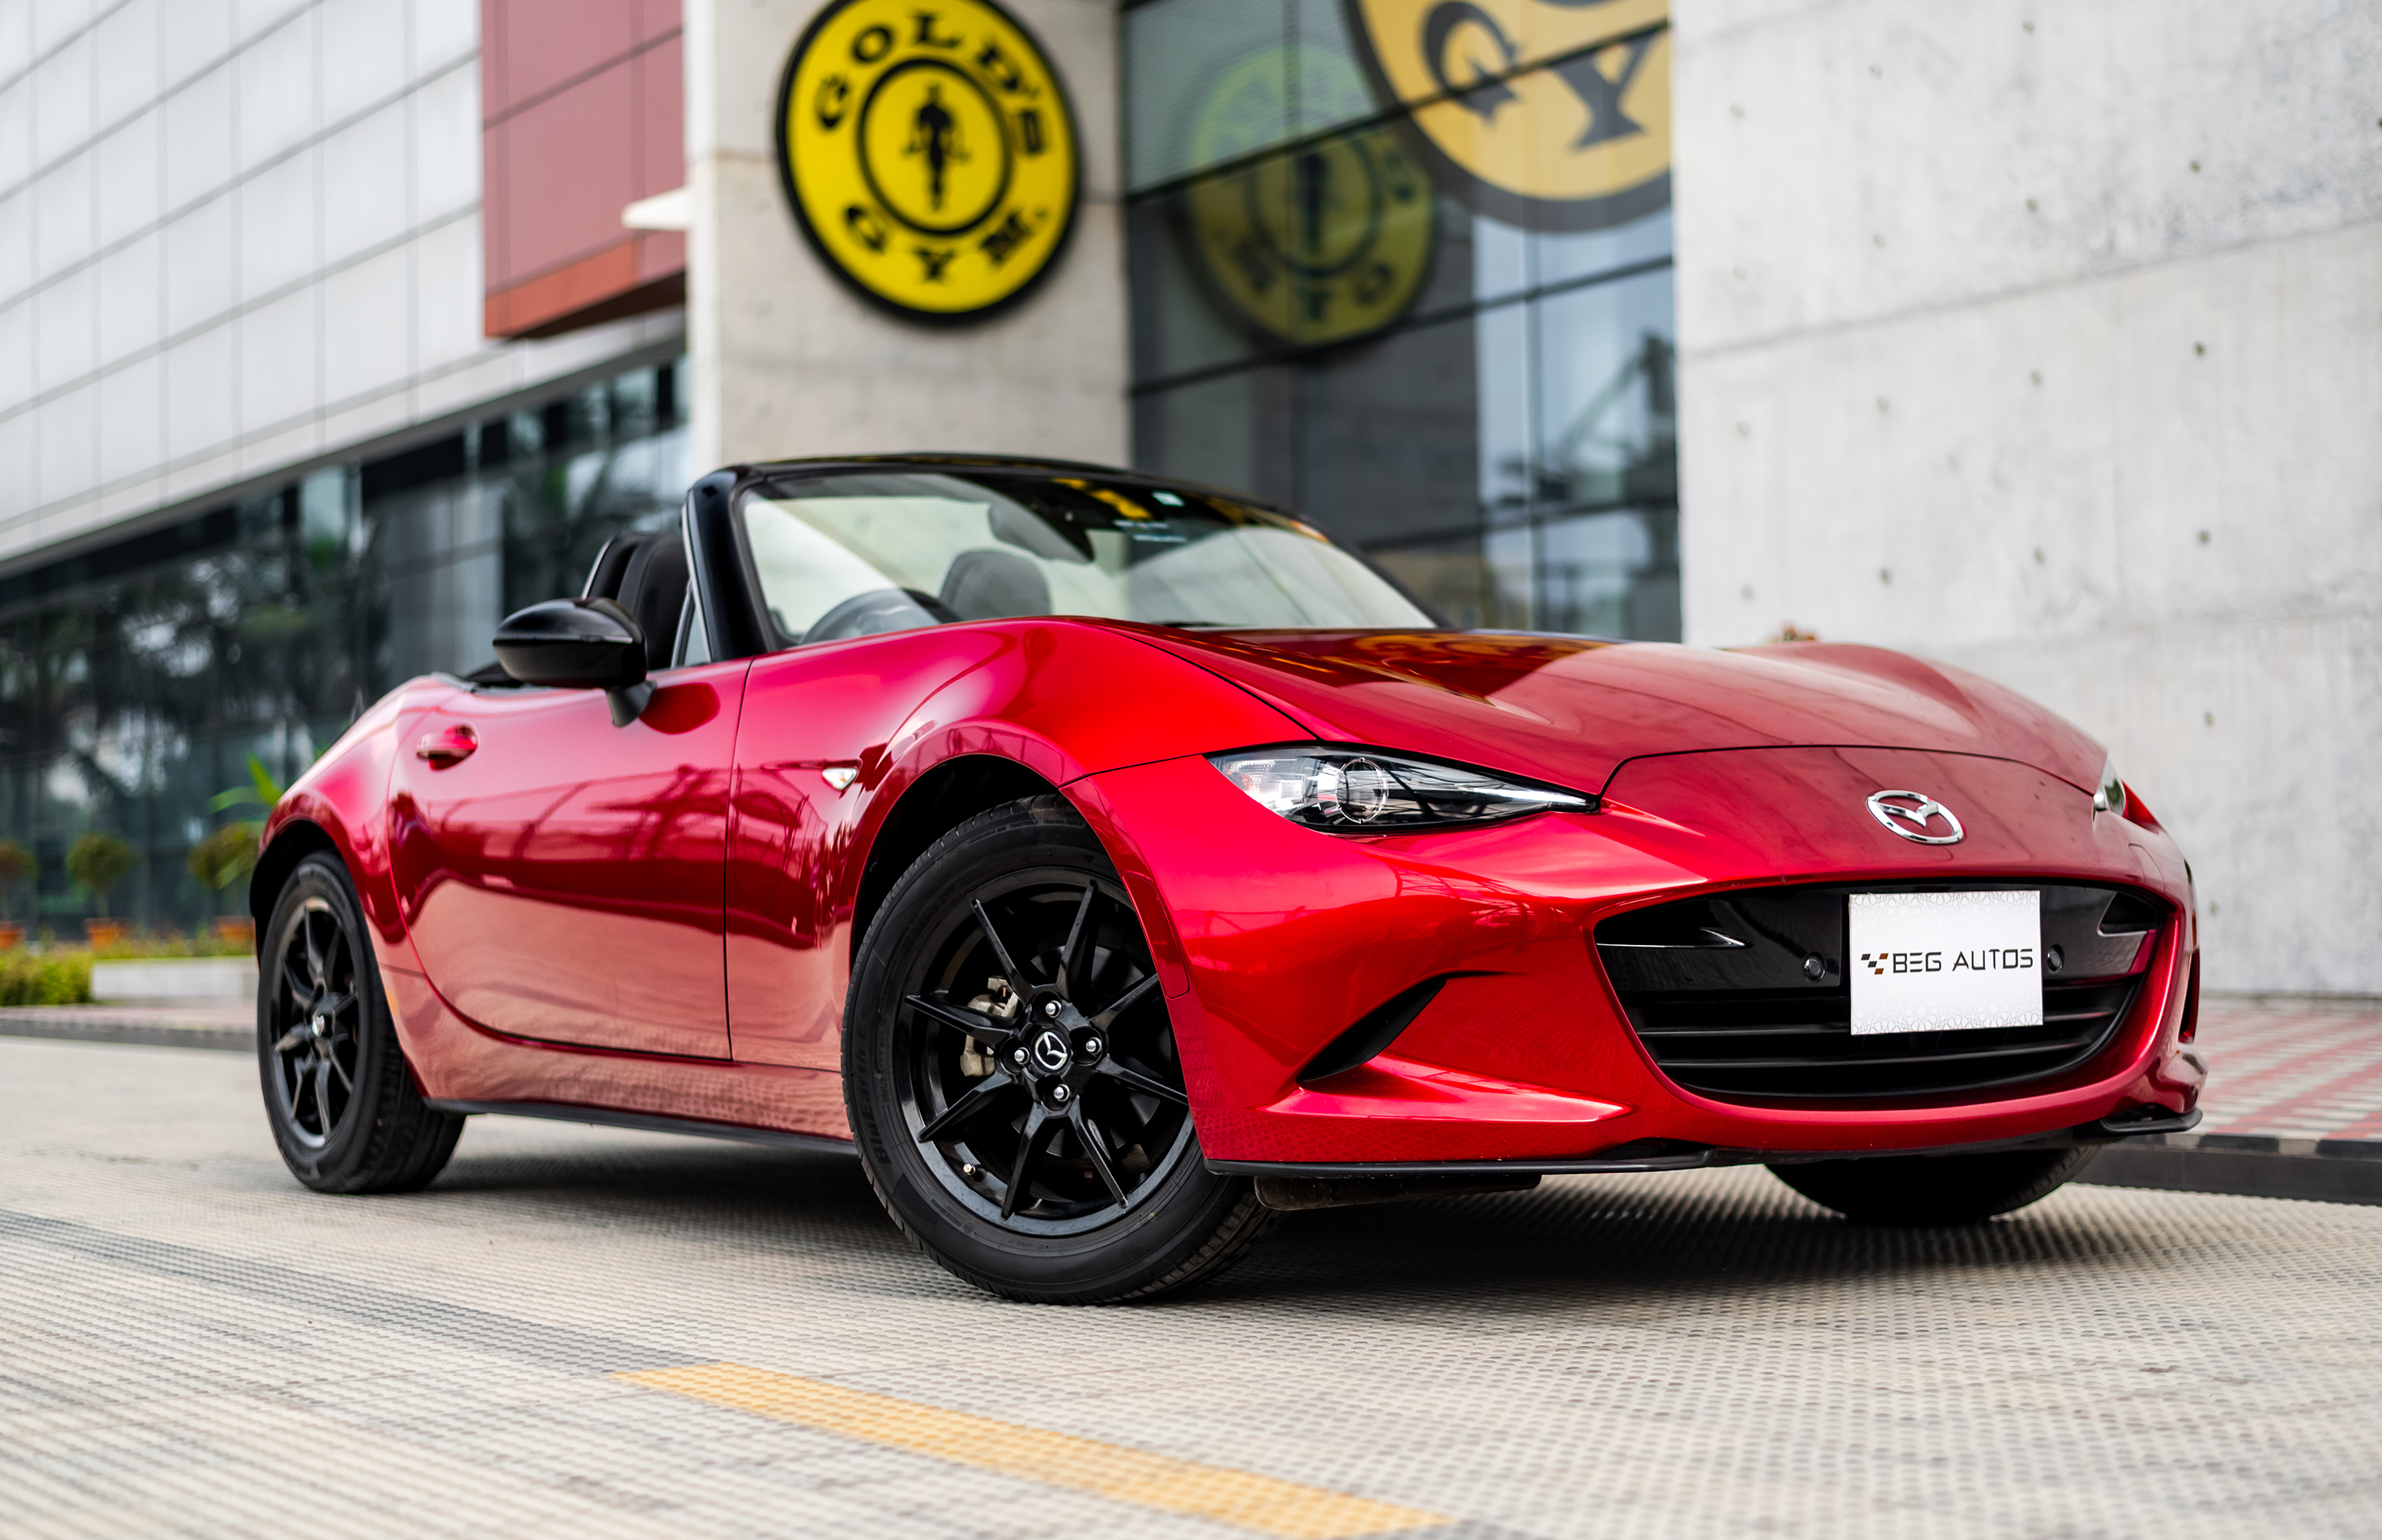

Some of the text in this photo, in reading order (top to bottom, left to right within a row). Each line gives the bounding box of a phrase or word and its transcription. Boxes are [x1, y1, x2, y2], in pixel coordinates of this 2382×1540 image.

[813, 11, 1047, 157] GOLD'S
[1892, 948, 2034, 974] BEG AUTOS
